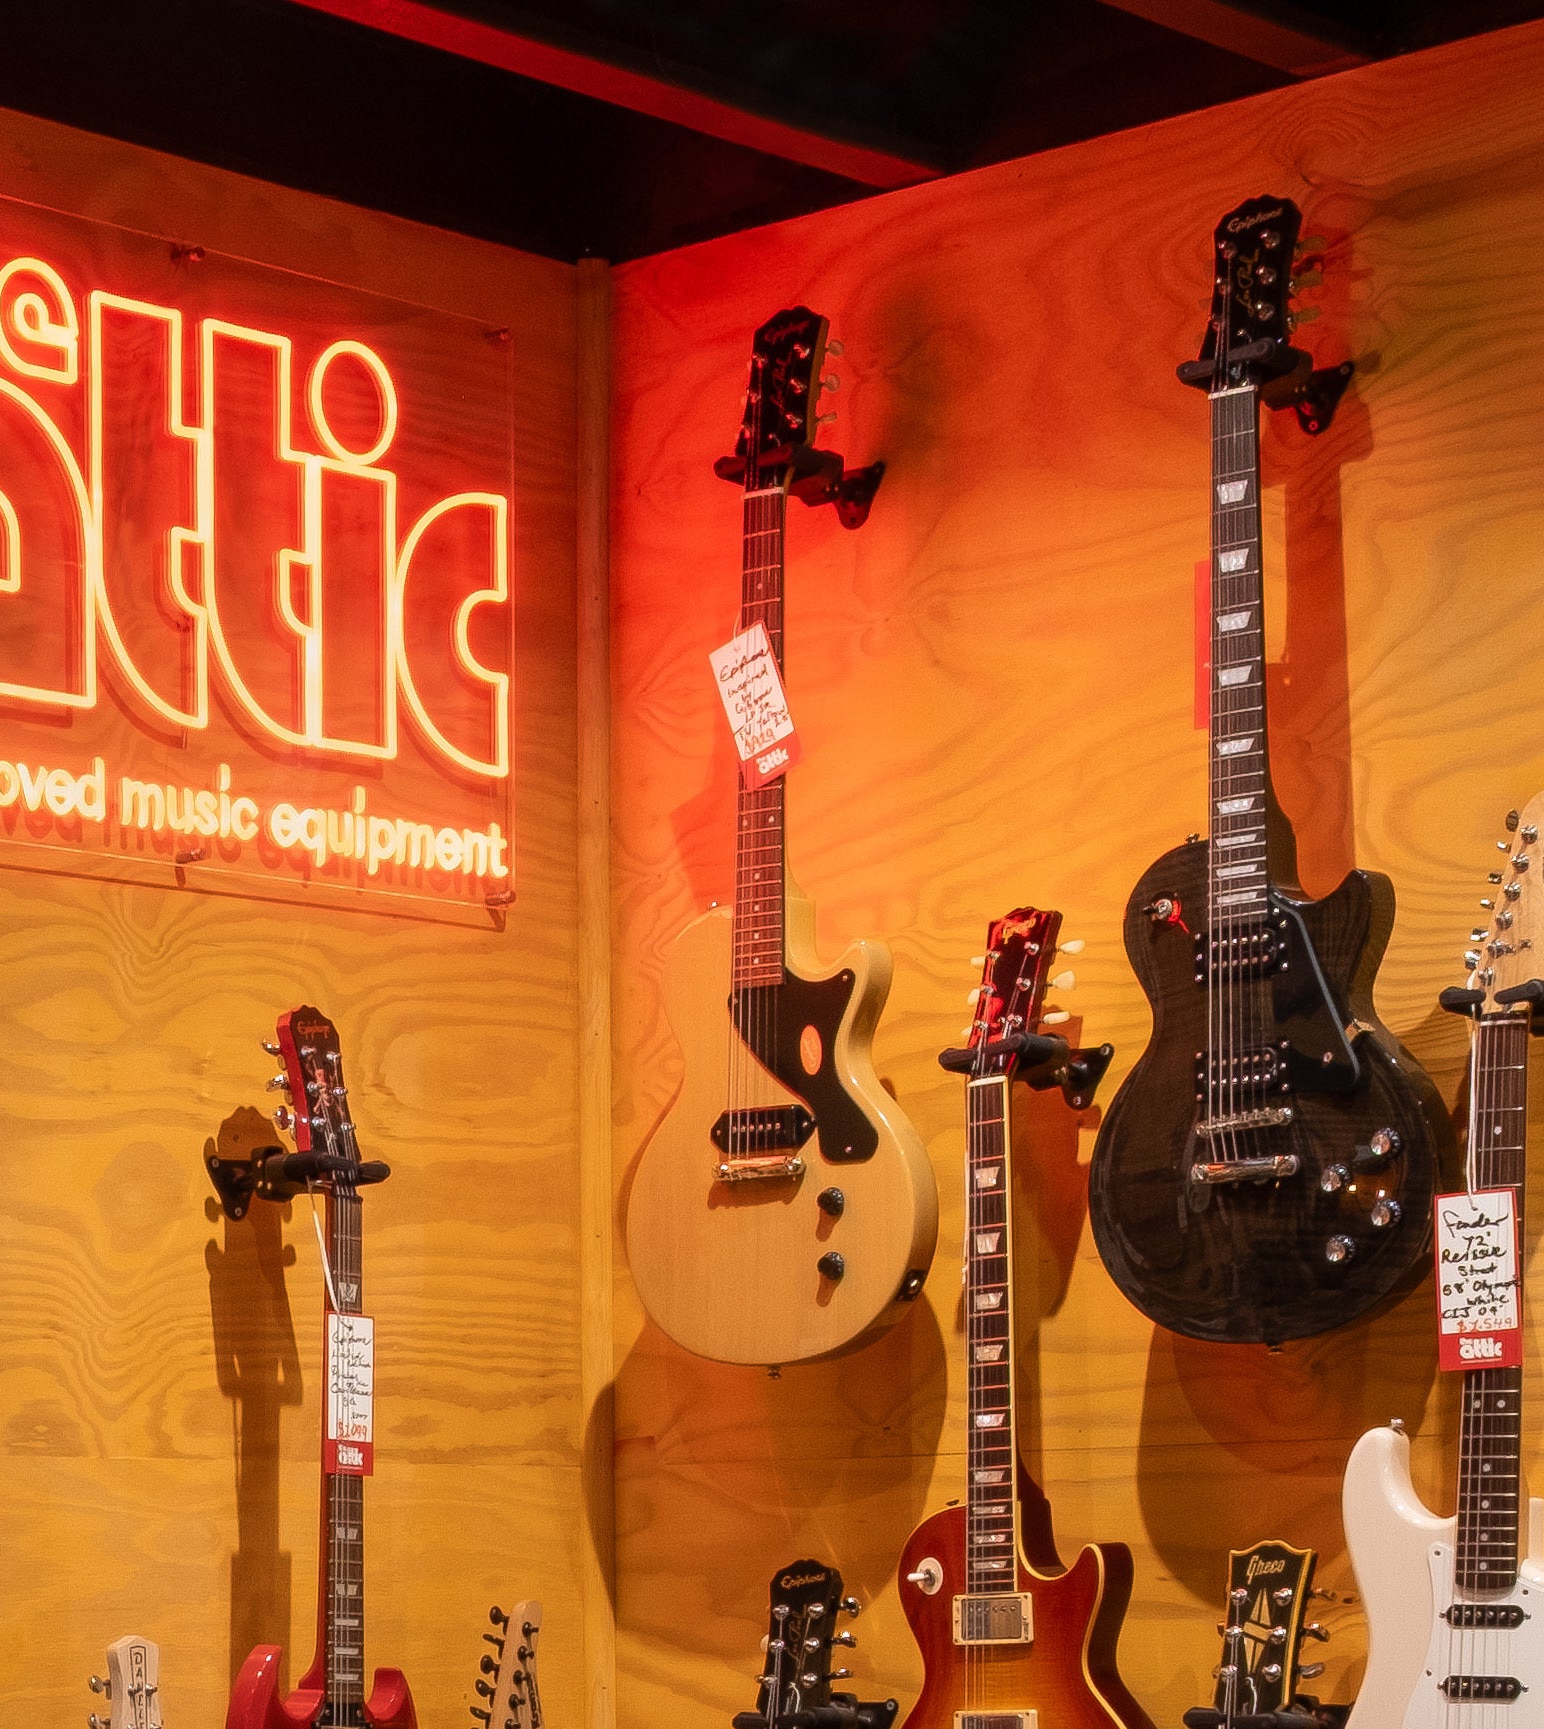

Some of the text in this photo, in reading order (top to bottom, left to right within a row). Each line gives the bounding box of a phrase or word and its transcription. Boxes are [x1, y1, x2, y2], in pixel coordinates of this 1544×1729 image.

[1226, 208, 1285, 233] Epiphone
[120, 764, 260, 842] music
[270, 786, 510, 878] equipment
[1460, 1336, 1503, 1361] attic
[781, 1574, 826, 1590] Epiphone
[1247, 1555, 1286, 1584] Greco
